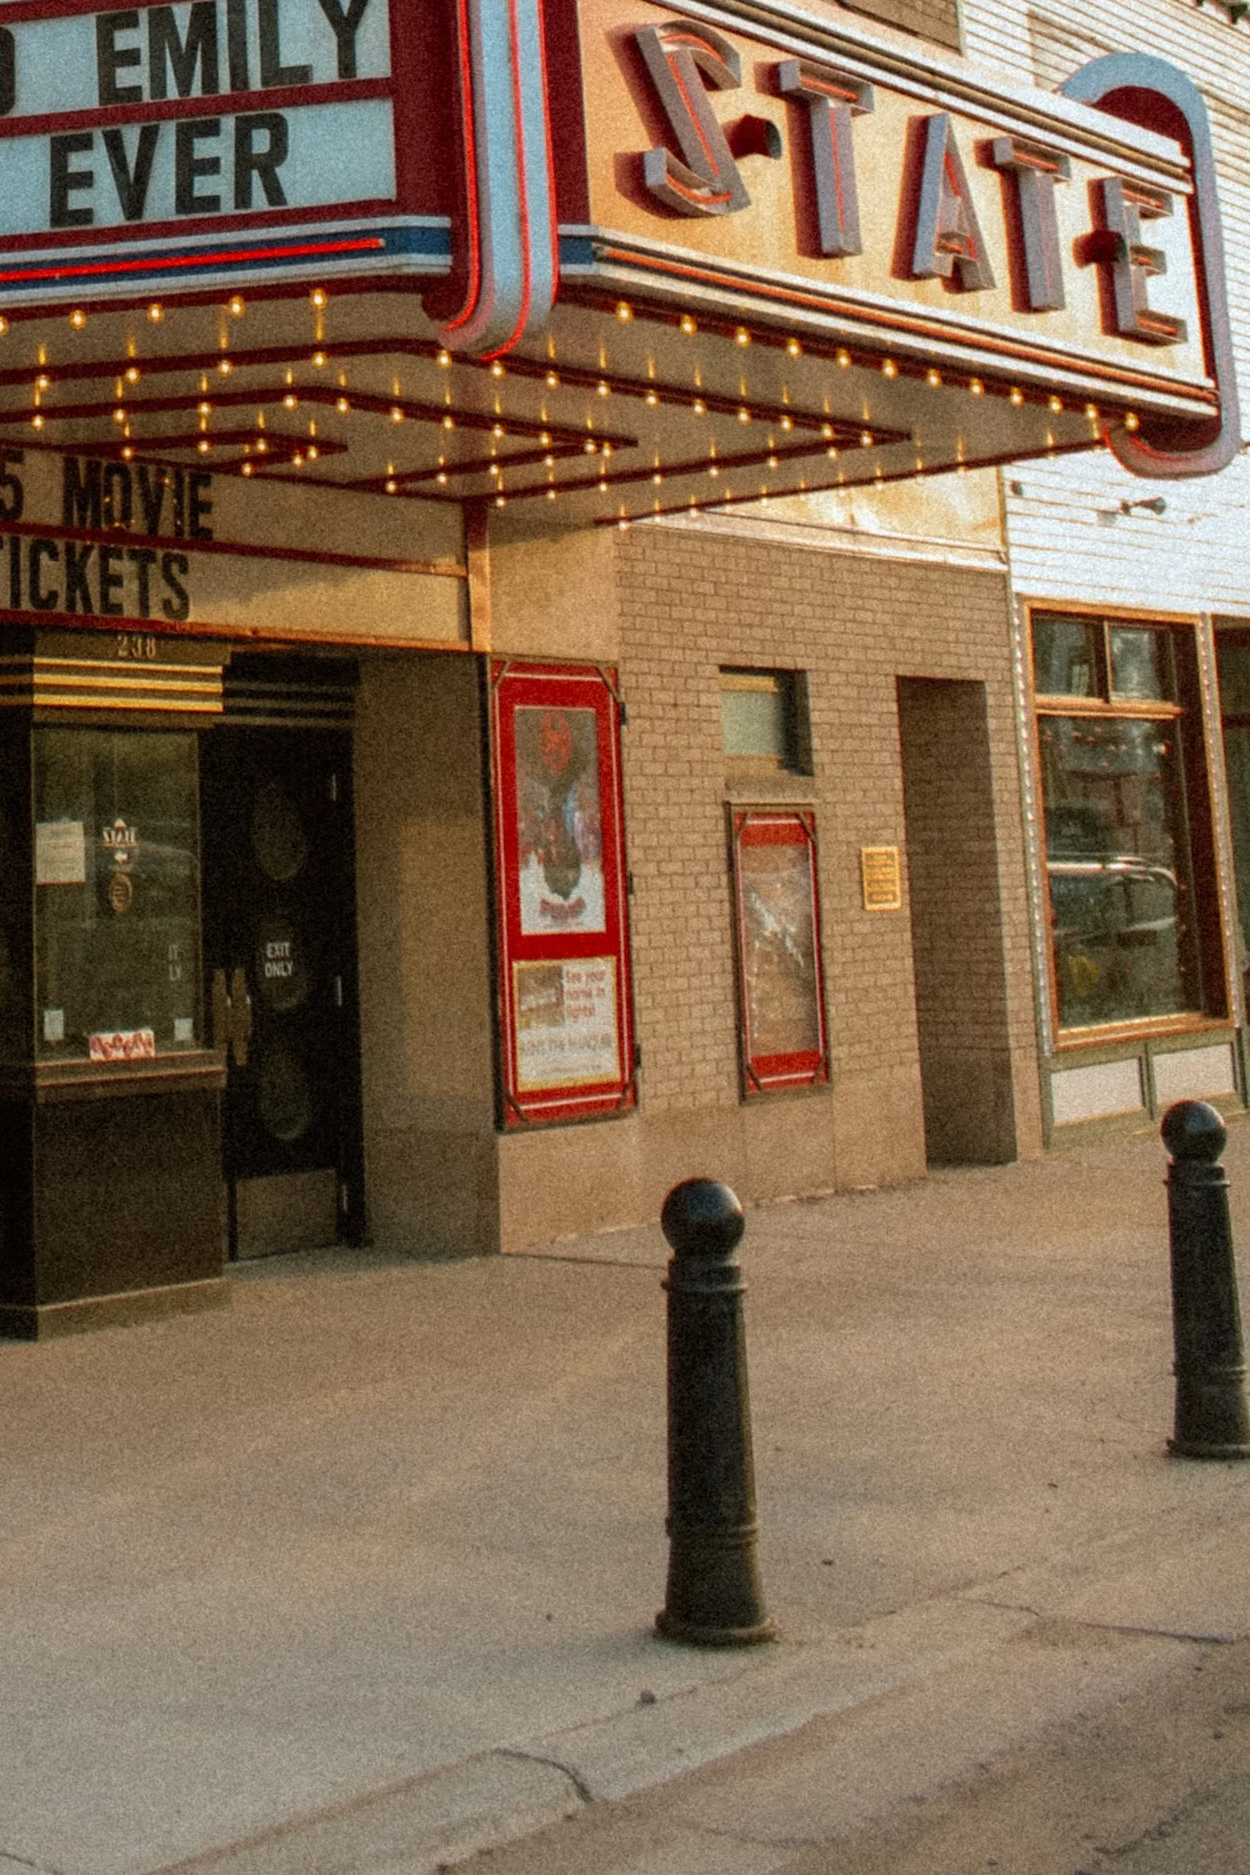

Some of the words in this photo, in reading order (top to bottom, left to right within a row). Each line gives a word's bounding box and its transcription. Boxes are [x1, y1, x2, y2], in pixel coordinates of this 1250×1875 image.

[50, 113, 289, 229] EVER
[630, 19, 1188, 346] STATE
[63, 456, 213, 541] MOVIE
[117, 635, 156, 658] 238
[265, 961, 293, 977] ONLY
[266, 942, 290, 958] EXIT
